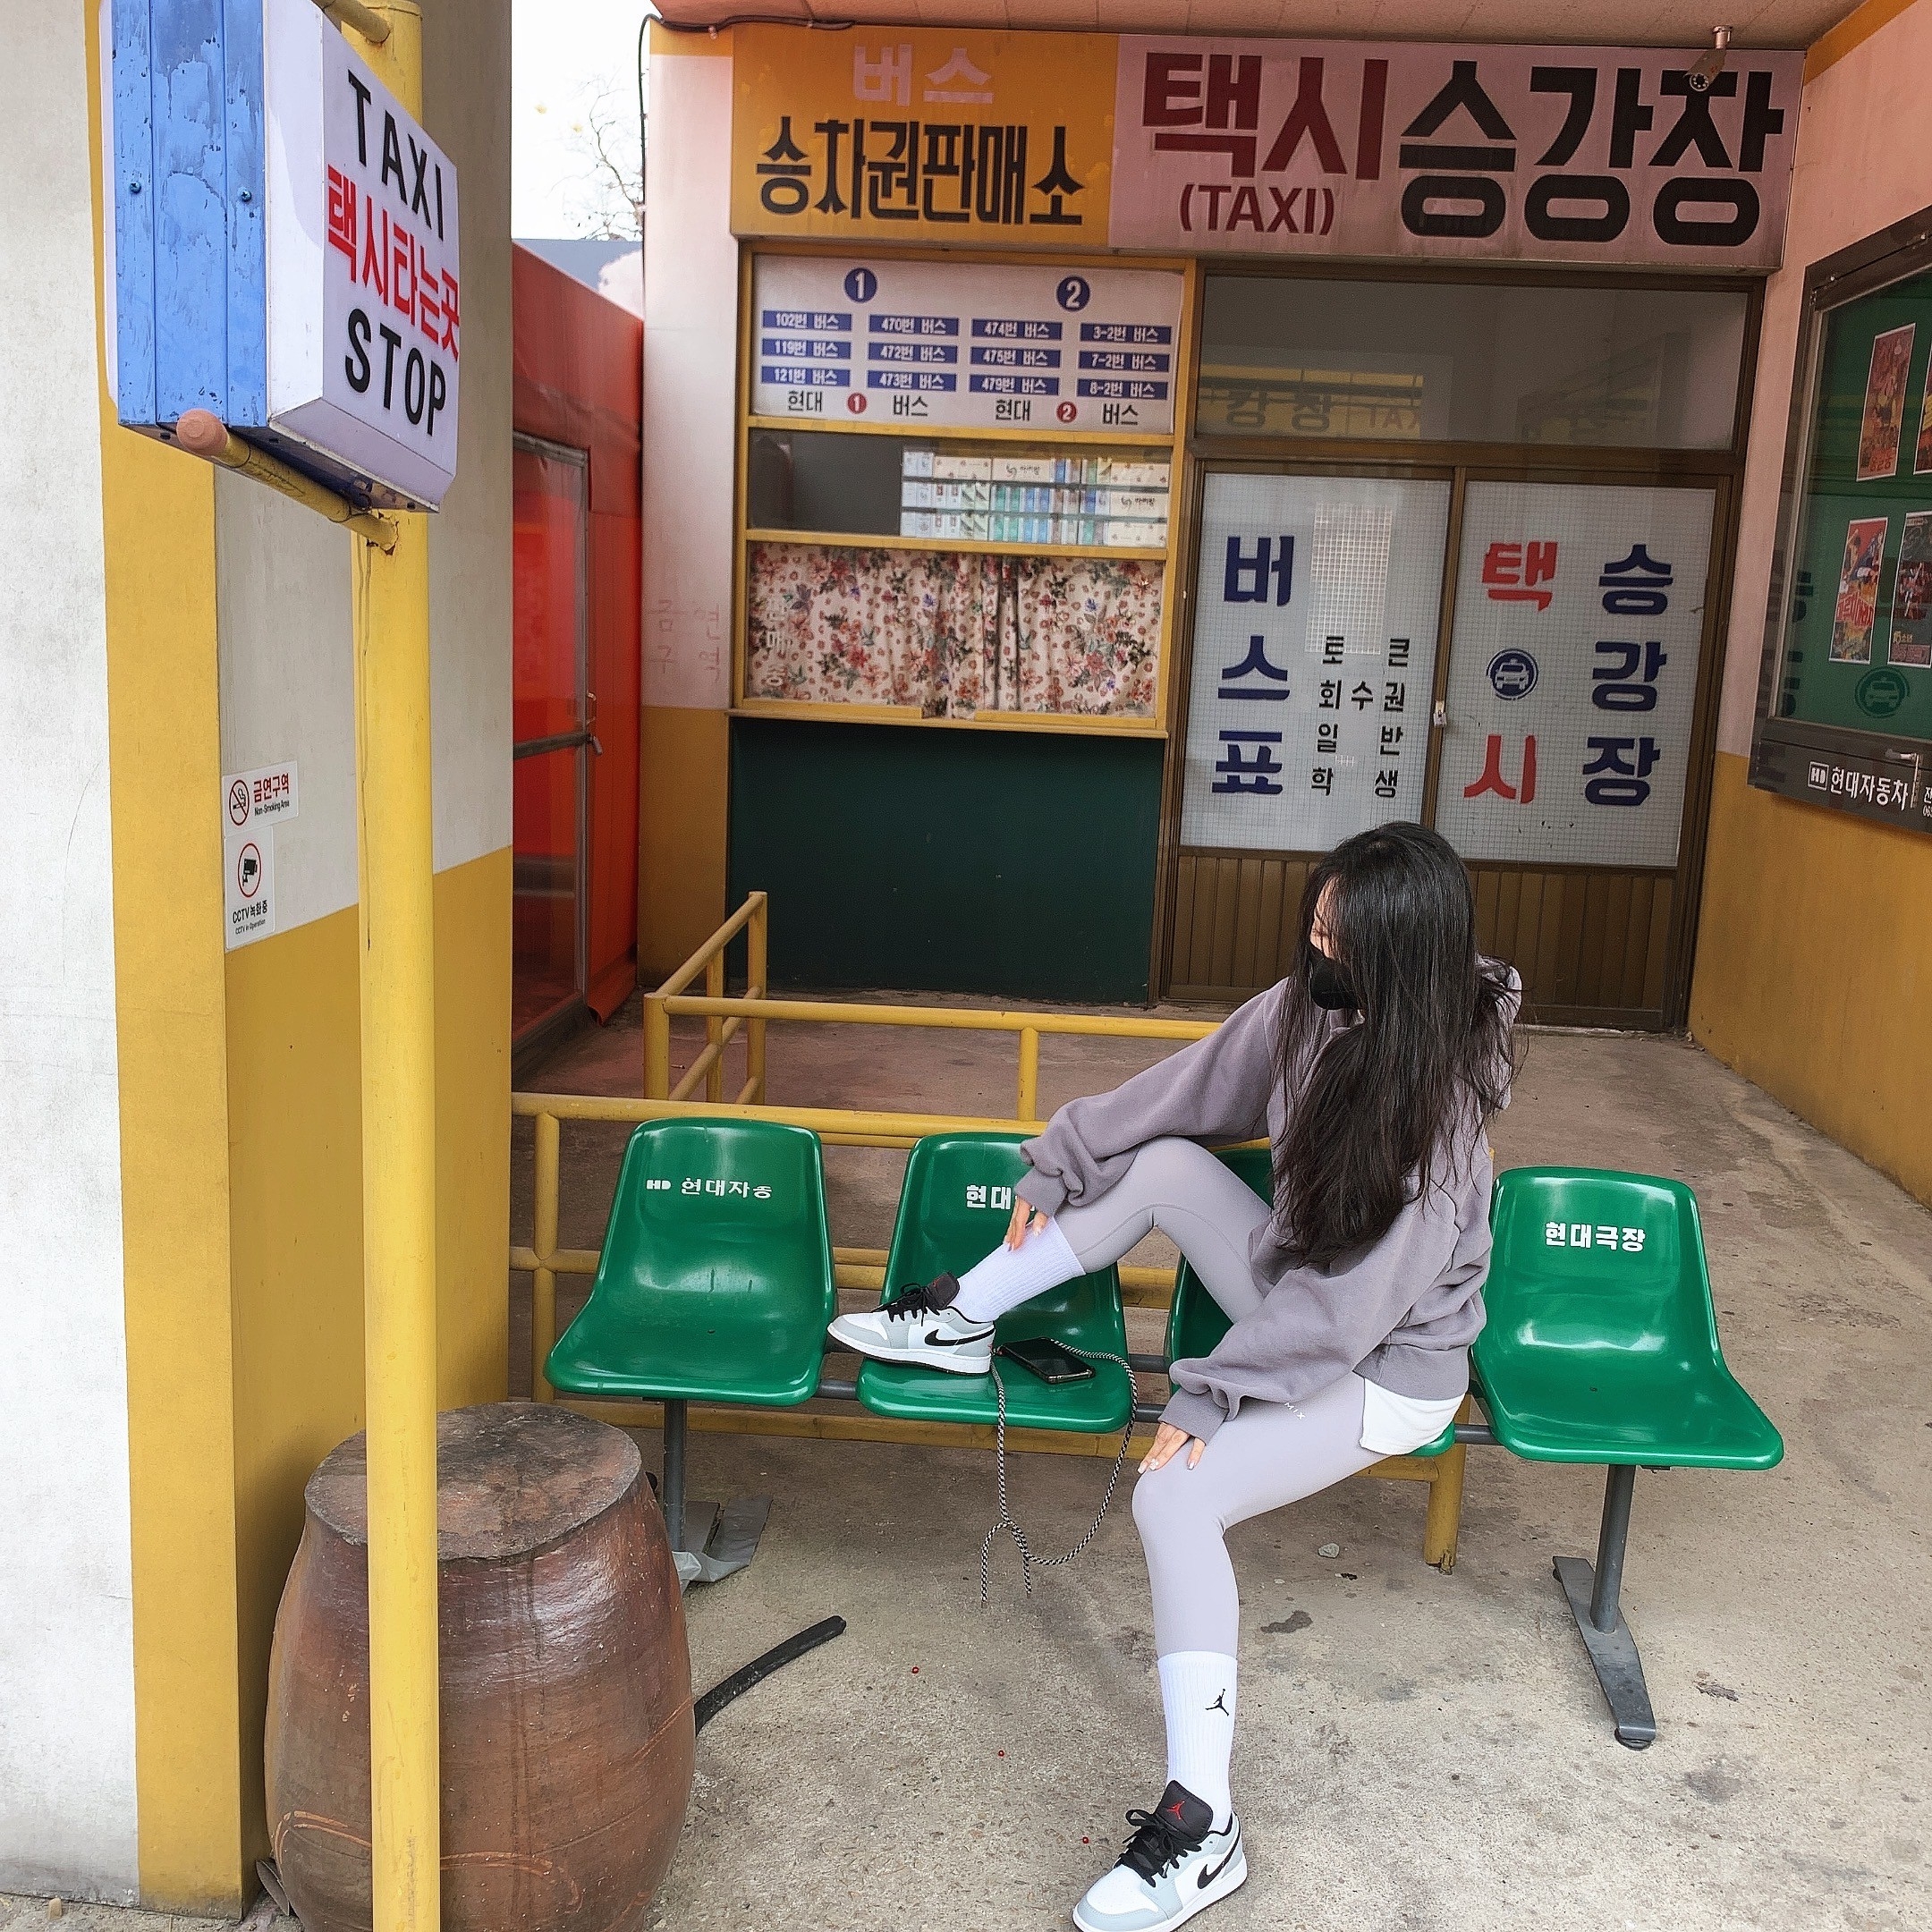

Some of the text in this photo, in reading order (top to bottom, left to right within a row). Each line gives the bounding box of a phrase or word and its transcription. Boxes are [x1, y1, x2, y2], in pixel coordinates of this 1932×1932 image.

[853, 44, 994, 106] 버스
[347, 68, 444, 242] TAXI
[1142, 52, 1784, 247] 택시 승강장
[756, 115, 1084, 225] 승차권판매소
[1180, 183, 1335, 237] (TAXI)
[814, 315, 839, 329] 버스
[921, 319, 946, 335] 버스
[1024, 323, 1050, 338] 버스
[1133, 326, 1159, 343] 버스
[813, 343, 838, 358] 버스
[920, 346, 945, 362] 버스
[1023, 351, 1047, 367] 버스
[1131, 355, 1157, 371] 버스
[344, 308, 446, 436] STOP
[812, 370, 837, 386] 버스
[919, 374, 945, 389] 버스
[1021, 378, 1046, 394] 버스
[787, 390, 823, 412] 현대
[893, 394, 928, 417] 버스
[1130, 383, 1155, 398] 버스
[995, 399, 1031, 421] 현대
[1102, 402, 1139, 426] 버스
[1211, 535, 1295, 795] 버스표
[1582, 543, 1674, 807] 승강장
[1318, 679, 1406, 713] 회수권
[1316, 723, 1404, 757] 일반
[253, 773, 289, 803] 금연구역
[1310, 767, 1399, 799] 학생
[1830, 766, 1909, 811] 현대자동차
[1545, 1221, 1646, 1252] 현대극장
